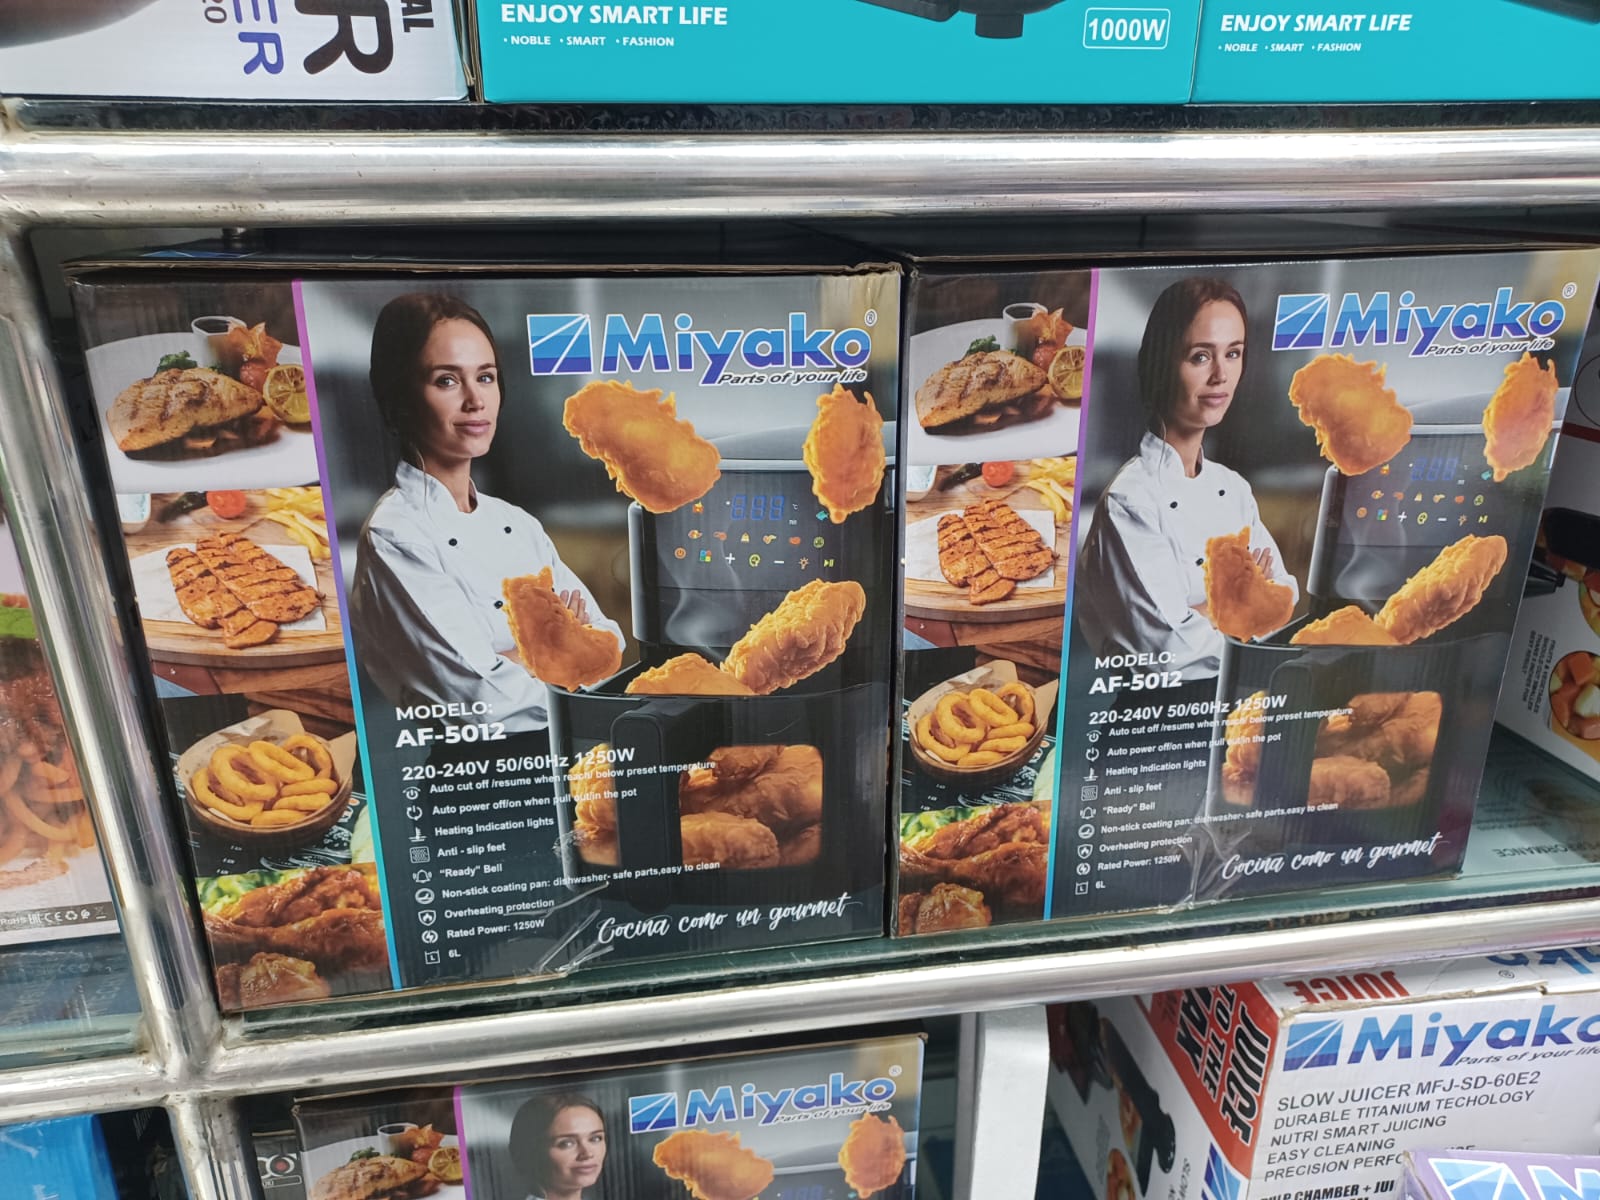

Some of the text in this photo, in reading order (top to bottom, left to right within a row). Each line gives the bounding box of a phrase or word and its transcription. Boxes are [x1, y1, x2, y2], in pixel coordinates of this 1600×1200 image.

[501, 4, 728, 25] ENJOY SMART LIFE
[1221, 14, 1413, 32] ENJOY SMART LIFE
[511, 35, 675, 47] NOBLE SMART FASHION
[1088, 18, 1166, 41] 1000W
[1224, 43, 1361, 52] NOBLE SMART FASHION
[1330, 287, 1566, 357] Miyako
[601, 312, 872, 386] Miyako
[1426, 338, 1555, 357] Parts of your life
[718, 369, 867, 386] Parts of your life
[1094, 651, 1176, 670] MODELO:
[1088, 670, 1183, 695] AF-5012
[395, 701, 493, 721] MODELO:
[1088, 694, 1288, 725] 220-240V 50/60Hz 1250W
[395, 722, 507, 748] AF-5012
[1108, 727, 1130, 737] Auto
[1131, 725, 1146, 735] cut
[1147, 723, 1160, 733] off
[1197, 718, 1220, 728] when
[1275, 711, 1303, 723] preset
[1107, 747, 1128, 757] Auto
[1129, 744, 1156, 756] power
[1184, 739, 1207, 749] when
[1252, 734, 1265, 743] the
[1267, 732, 1282, 743] pot
[401, 747, 635, 780] 220-240V 50/60Hz 1250W
[1105, 759, 1207, 777] Heating Indication lights
[430, 784, 454, 794] Auto
[456, 782, 473, 792] cut
[475, 779, 489, 790] off
[534, 773, 560, 785] when
[626, 766, 657, 778] preset
[659, 761, 716, 774] temperature
[1104, 787, 1123, 797] Anti
[1128, 784, 1144, 794] slip
[1146, 782, 1162, 792] feet
[432, 805, 456, 815] Auto
[459, 803, 490, 814] power
[523, 797, 550, 807] when
[553, 794, 571, 805] pull
[603, 789, 619, 799] the
[621, 788, 637, 799] pot
[1139, 802, 1156, 811] Bell
[434, 817, 554, 837] Heating Indication lights
[1101, 822, 1140, 834] Non-stick
[1142, 820, 1172, 831] coating
[1245, 810, 1262, 819] safe
[1307, 804, 1315, 812] to
[1317, 802, 1338, 811] clean
[437, 847, 458, 857] Anti
[466, 845, 484, 855] slip
[486, 842, 506, 852] feet
[1099, 836, 1193, 852] Overheating protection
[1097, 855, 1181, 871] Rated Power: 1250W
[1222, 832, 1443, 880] Cocina como un gourmet
[483, 864, 503, 873] Bell
[442, 886, 489, 899] Non-stick
[491, 883, 527, 894] coating
[530, 880, 551, 891] pan:
[613, 870, 632, 880] safe
[684, 864, 694, 872] to
[696, 862, 720, 871] clean
[444, 899, 554, 918] Overheating protection
[598, 892, 852, 944] Cocina como un gourmet
[447, 919, 545, 938] Rated Power: 1250W
[448, 949, 461, 958] 6L
[1283, 971, 1410, 1004] JUICE
[1201, 1028, 1227, 1102] THE
[1455, 1054, 1501, 1066] Parts
[1505, 1051, 1527, 1062] of
[1528, 1048, 1576, 1061] your
[1220, 1001, 1271, 1145] JUICE
[683, 1072, 896, 1127] Miyako
[1277, 1071, 1541, 1111] SLOW JUICER MFJ-SD-60E2
[1274, 1090, 1534, 1130] DURABLE TITANIUM TECHOLOGY
[1270, 1115, 1447, 1147] NUTRI SMART JUICING
[1267, 1137, 1396, 1165] EASY CLEANING
[1264, 1159, 1349, 1182] PRECISION
[1294, 1183, 1360, 1200] CHAMBER
